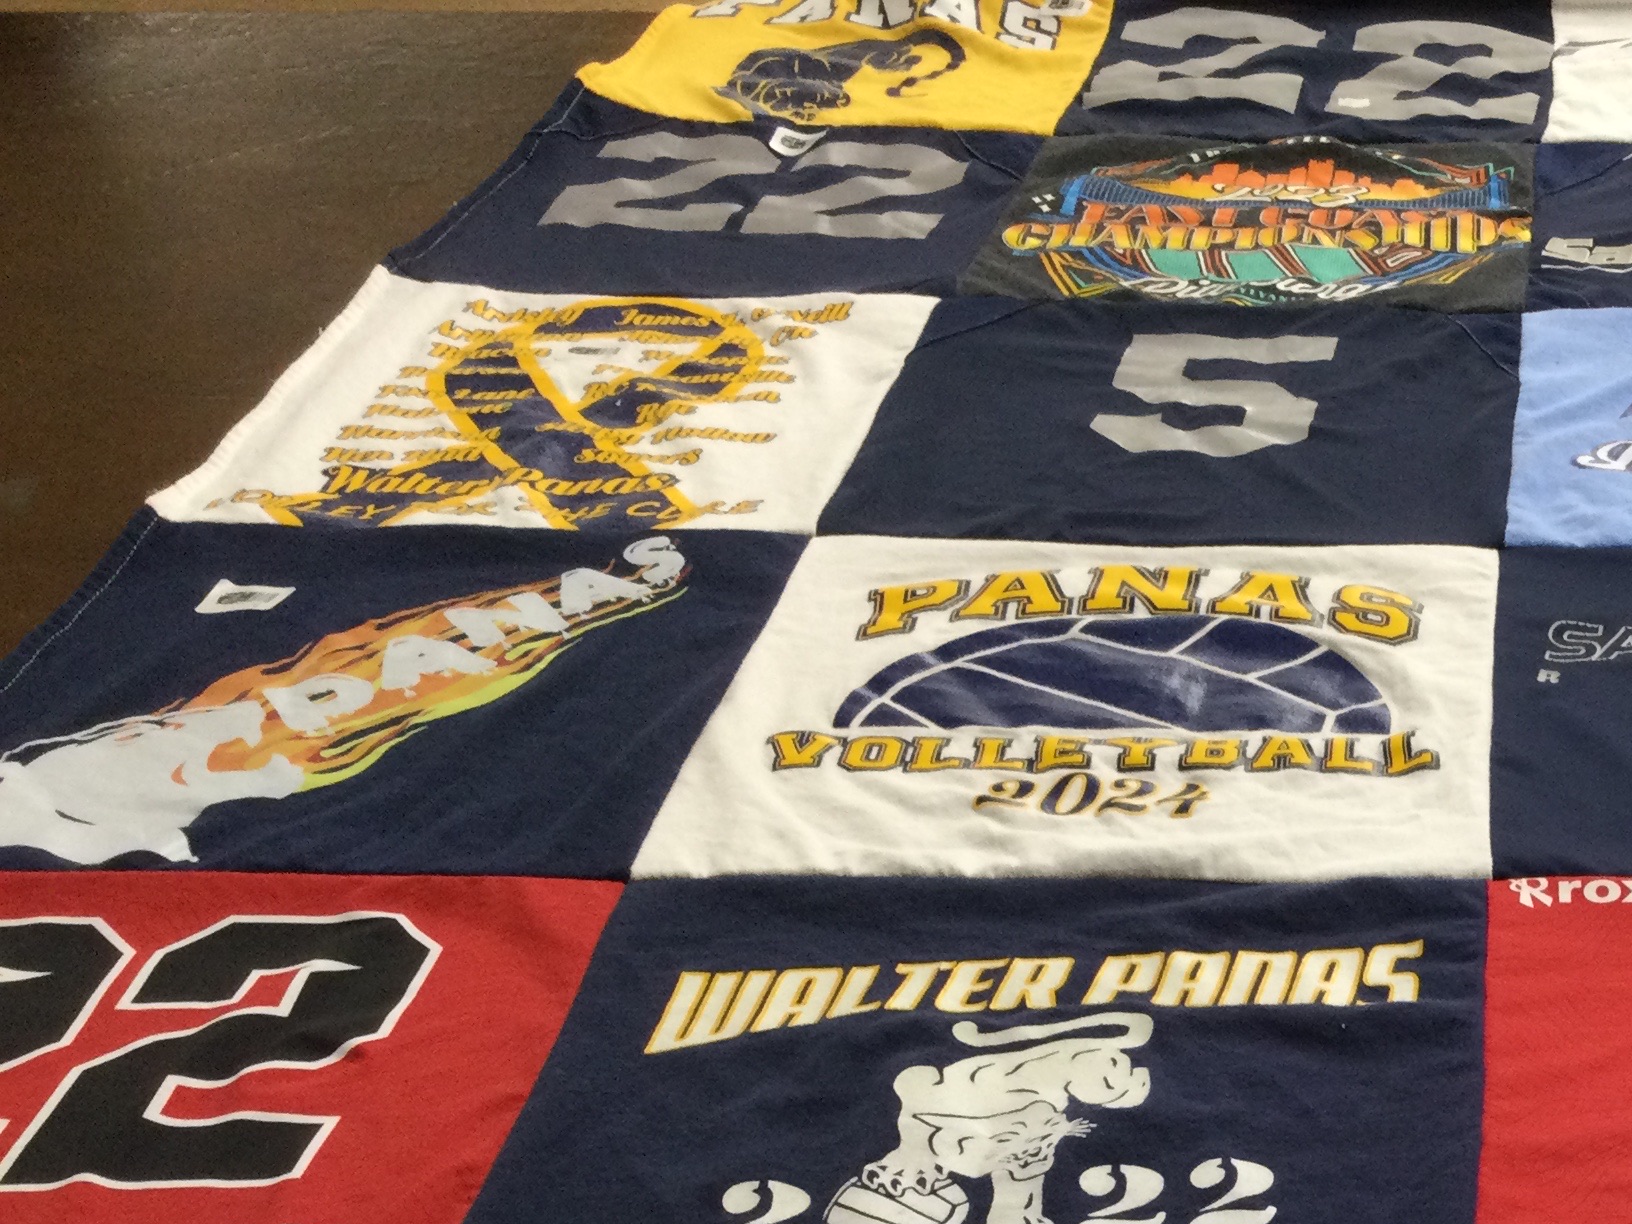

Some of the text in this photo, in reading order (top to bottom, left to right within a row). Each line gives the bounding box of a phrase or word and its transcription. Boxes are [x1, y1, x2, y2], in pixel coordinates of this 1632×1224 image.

[1082, 7, 1556, 125] 22
[537, 131, 971, 239] 22
[1089, 333, 1339, 458] 5
[320, 464, 682, 496] Walter Panas
[262, 535, 691, 738] PANAS
[855, 565, 1425, 645] PANAS
[766, 729, 1441, 777] VOLLEYBALL
[972, 771, 1212, 819] 2024
[643, 939, 1425, 1055] WALTER PANAS
